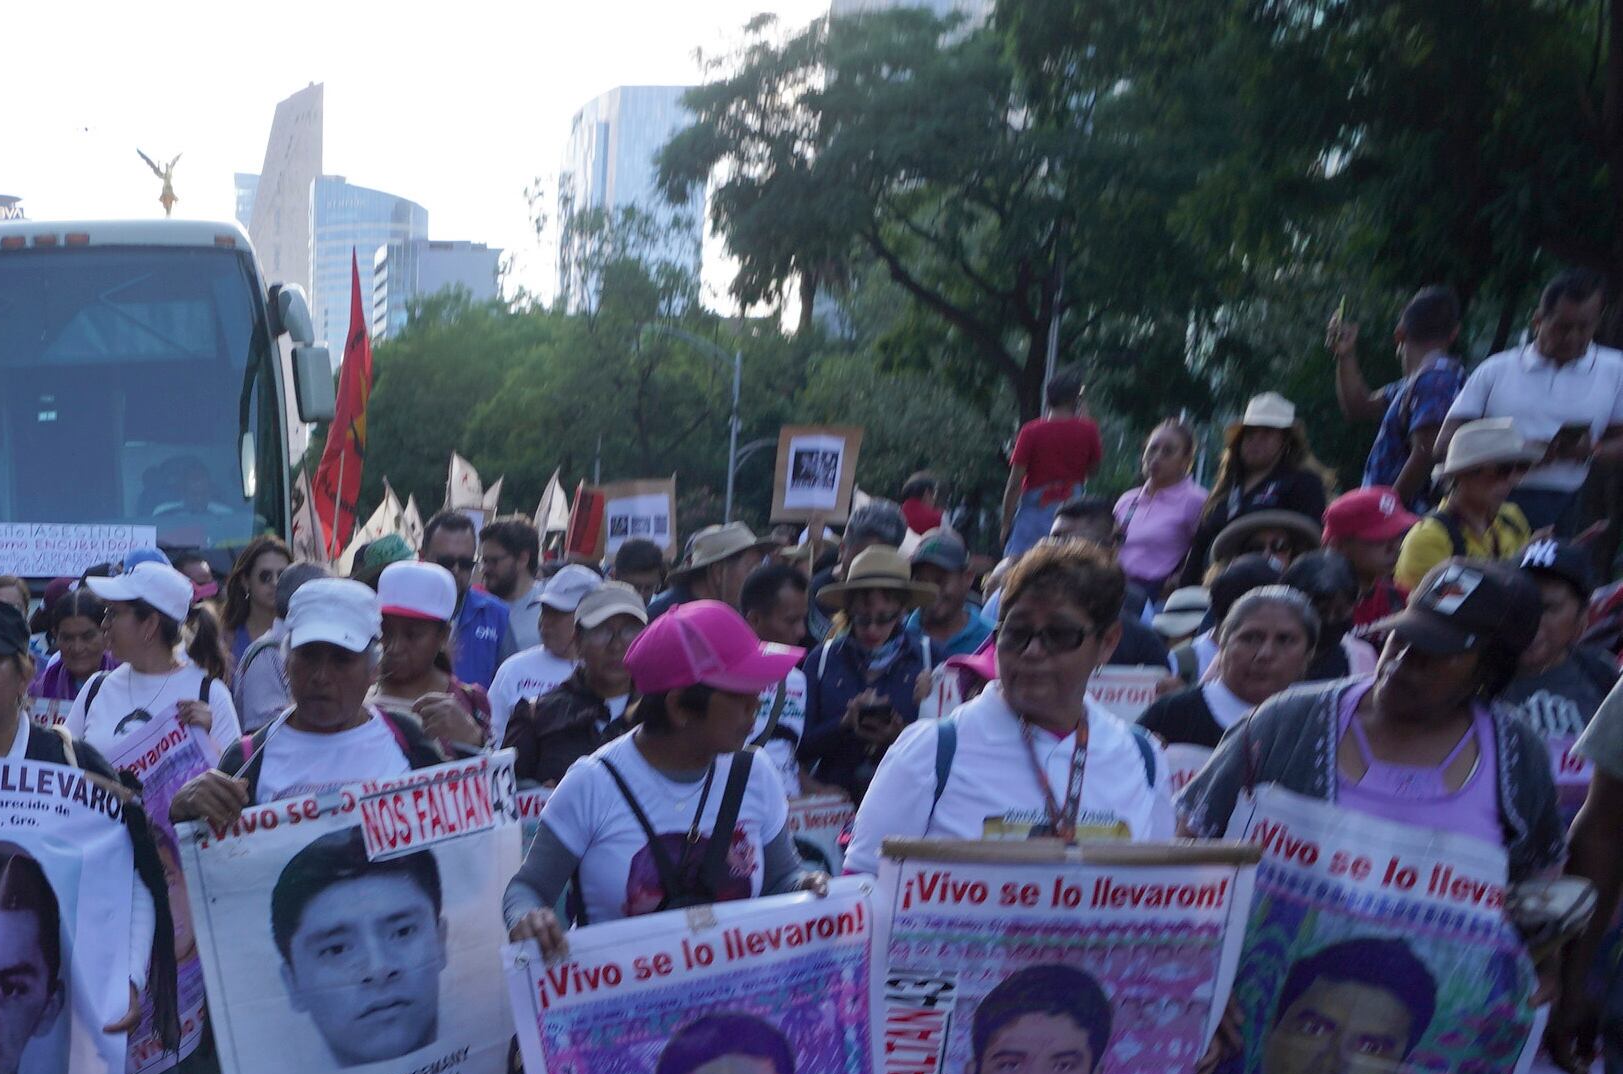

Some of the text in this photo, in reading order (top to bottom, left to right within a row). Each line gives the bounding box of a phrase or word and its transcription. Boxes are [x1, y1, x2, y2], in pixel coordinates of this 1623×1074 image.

[54, 804, 71, 818] de
[286, 799, 320, 824] se
[359, 795, 412, 853] NOS
[411, 773, 494, 842] FALTAN
[902, 869, 1231, 912] ¡Vivo se lo llevaron!
[1327, 849, 1373, 881] se
[1382, 854, 1420, 892] lo
[537, 961, 623, 1009] ¡Vivo
[633, 951, 673, 982] se
[681, 937, 714, 971] lo
[722, 902, 866, 961] llevaron!
